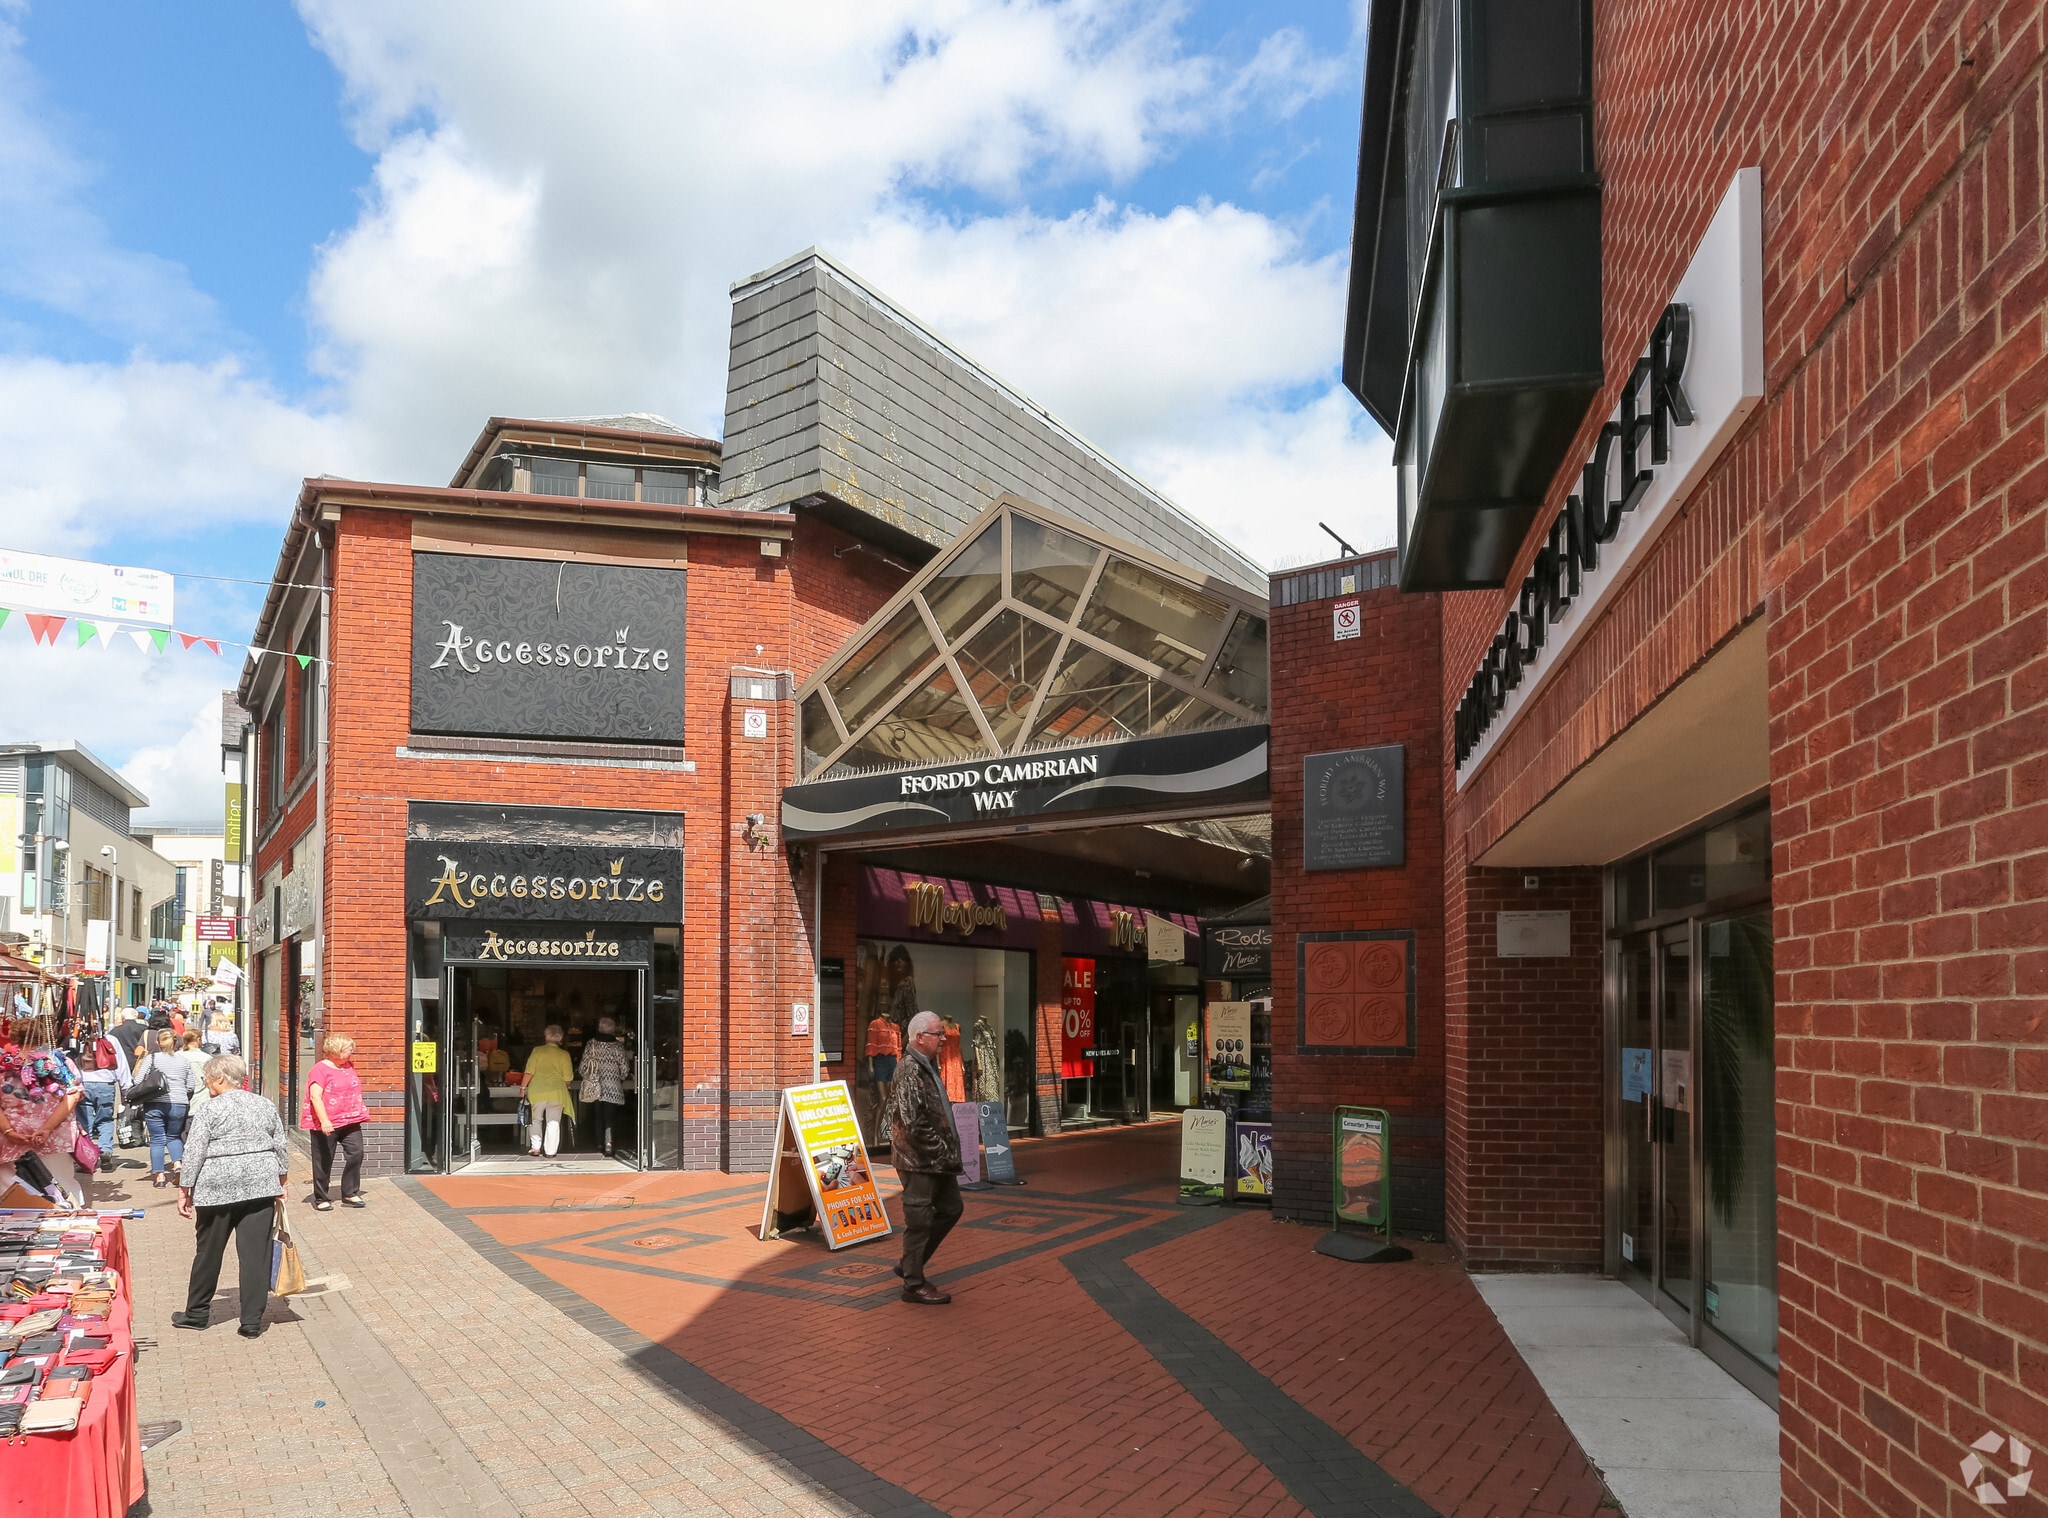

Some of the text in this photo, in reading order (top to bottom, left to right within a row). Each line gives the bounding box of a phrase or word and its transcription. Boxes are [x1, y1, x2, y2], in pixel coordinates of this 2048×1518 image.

[29, 571, 48, 584] DRE
[1334, 600, 1359, 609] DANGER
[429, 620, 669, 674] Accessorize
[900, 754, 1098, 794] FFORDD CAMBRIAN
[1335, 755, 1384, 778] CAMBRIAN
[1376, 779, 1386, 800] WAY
[972, 790, 1018, 812] WAY
[425, 855, 665, 909] Accessorize
[911, 881, 1007, 936] Monsoon
[478, 929, 619, 960] Accessorize
[1214, 929, 1272, 946] Rod's
[212, 946, 237, 956] hotte
[1063, 970, 1091, 988] ALE
[1073, 997, 1081, 1005] TO
[1080, 1030, 1091, 1038] OFF
[823, 1088, 844, 1098] fone
[797, 1104, 849, 1122] UNLOCKING
[827, 1192, 876, 1211] PHONES FOR SALE
[853, 1227, 863, 1235] Paid
[869, 1222, 885, 1230] Phones
